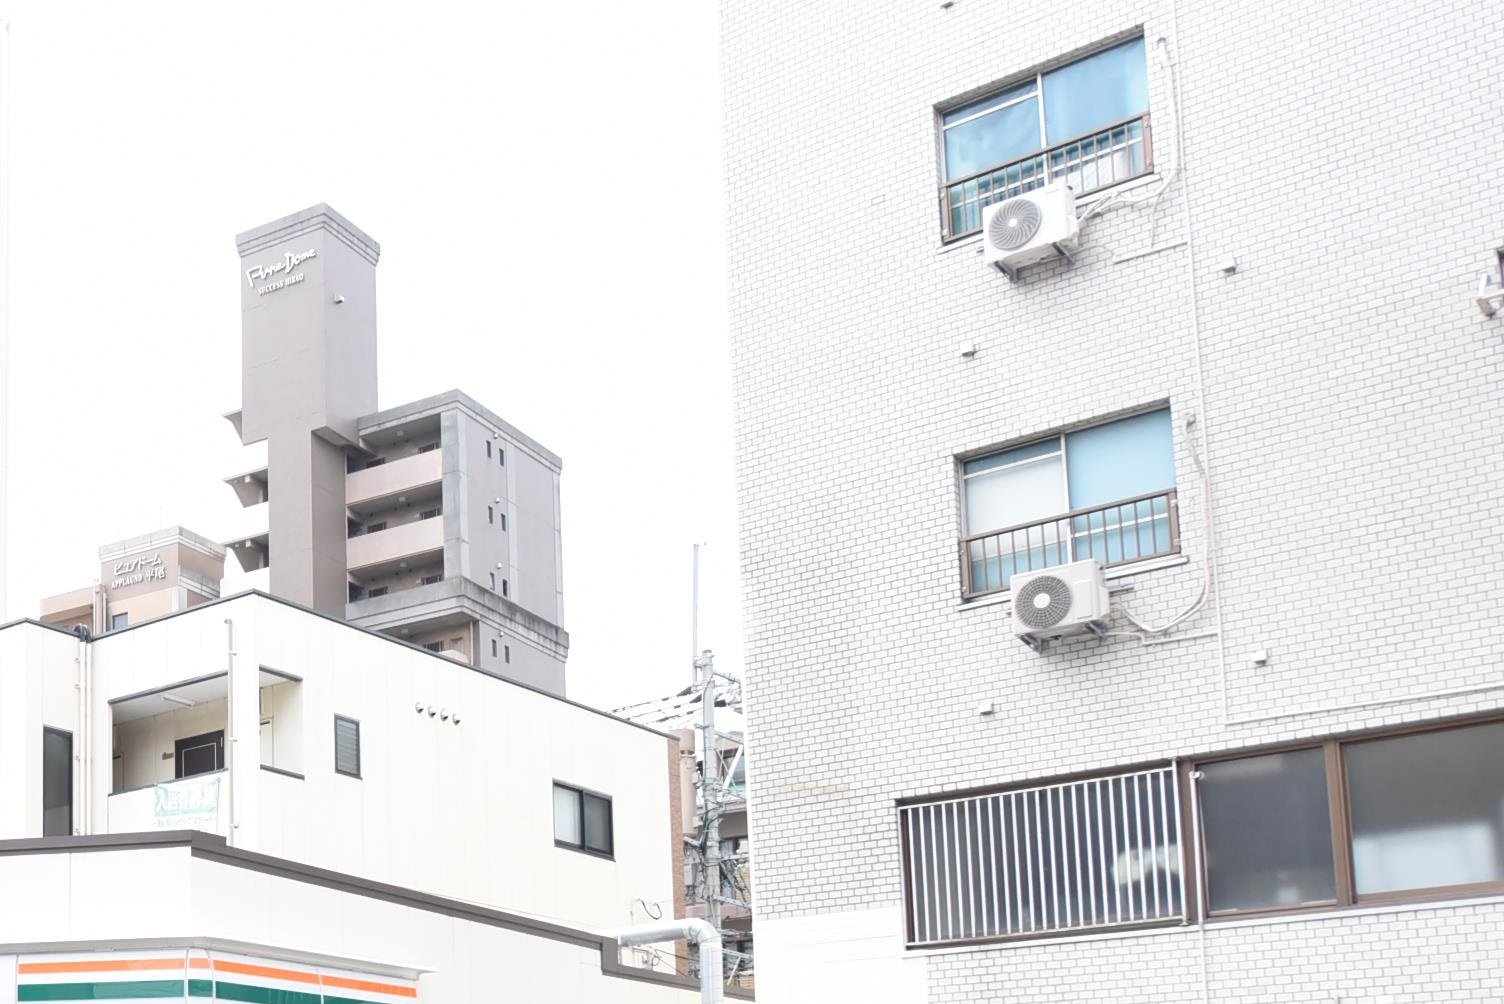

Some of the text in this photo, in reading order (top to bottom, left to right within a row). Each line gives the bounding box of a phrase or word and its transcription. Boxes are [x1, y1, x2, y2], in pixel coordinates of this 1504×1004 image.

[284, 248, 316, 273] Dome
[114, 553, 162, 576] ピュアドーム
